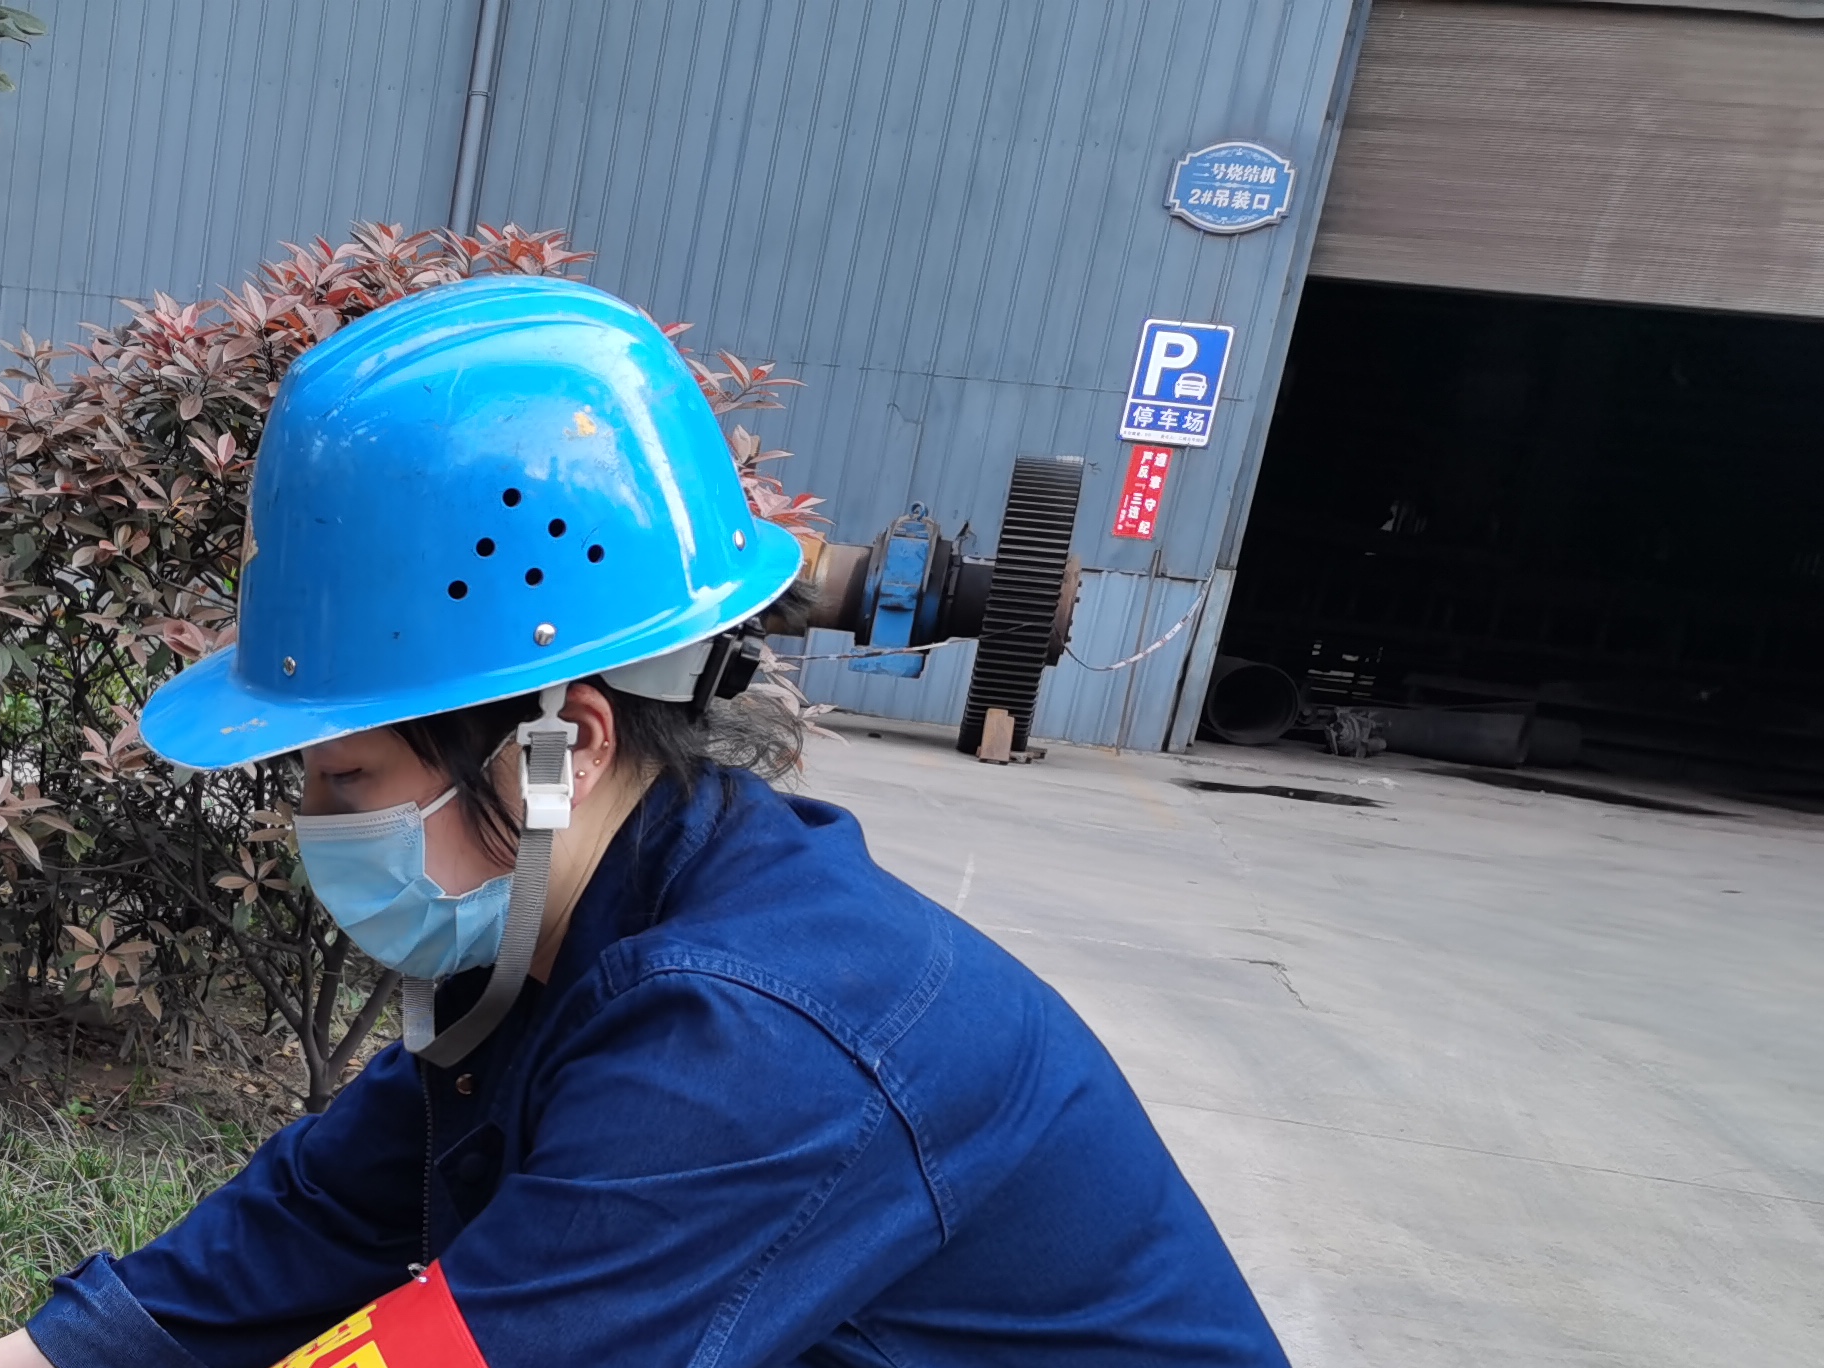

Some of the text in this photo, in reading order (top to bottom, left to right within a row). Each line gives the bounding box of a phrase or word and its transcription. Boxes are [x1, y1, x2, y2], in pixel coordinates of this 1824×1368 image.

[1192, 163, 1276, 184] 二号烧结机
[1188, 188, 1271, 210] 2#吊装口
[1142, 330, 1198, 396] P
[1132, 405, 1206, 433] 停车场
